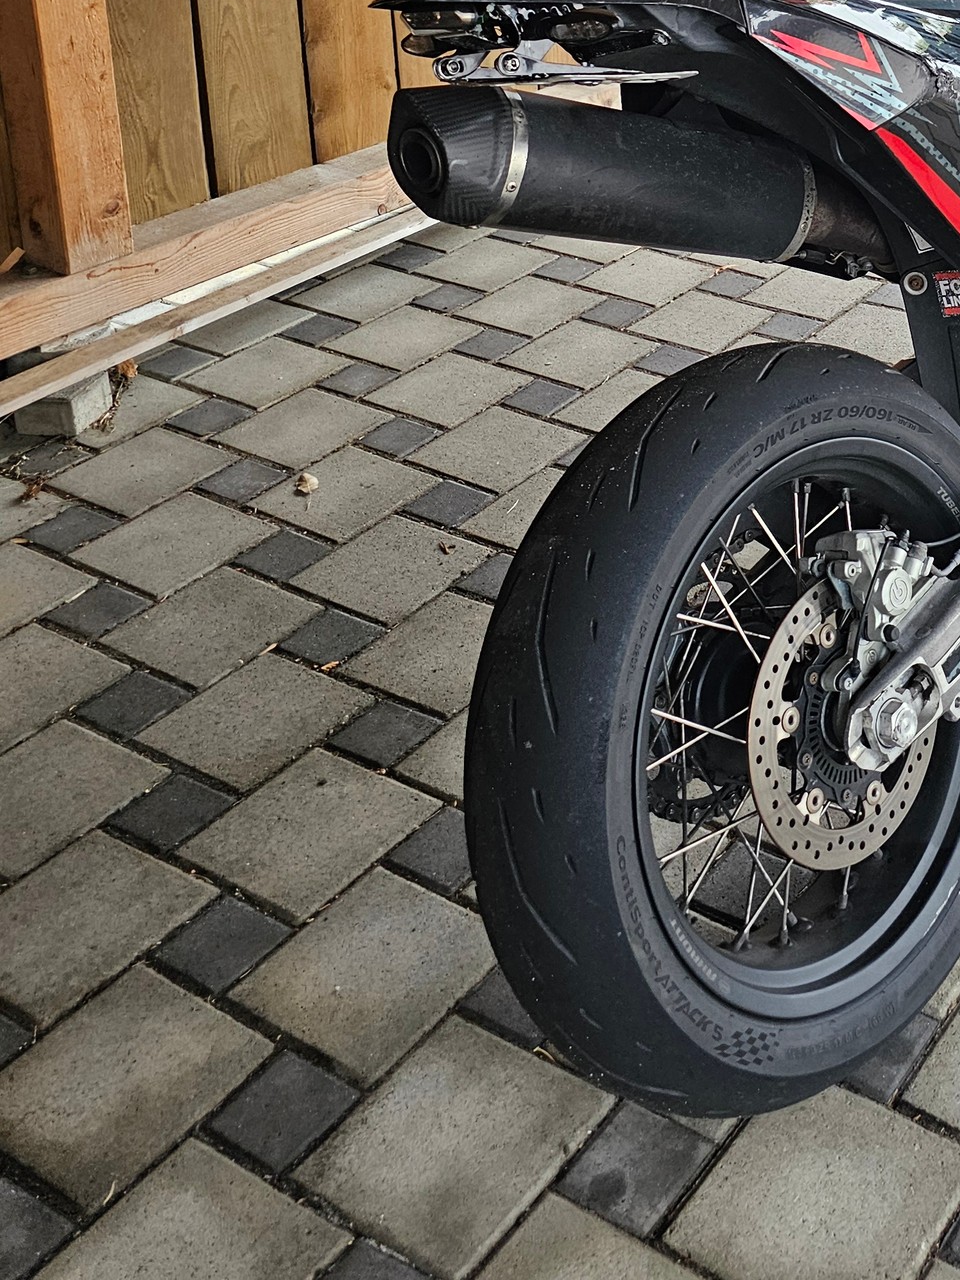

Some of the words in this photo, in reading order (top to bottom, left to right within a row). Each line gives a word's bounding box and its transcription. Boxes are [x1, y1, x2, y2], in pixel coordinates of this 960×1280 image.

[811, 408, 834, 425] ZR
[837, 405, 893, 420] 160/60
[789, 418, 809, 435] 17
[753, 428, 786, 459] M/C
